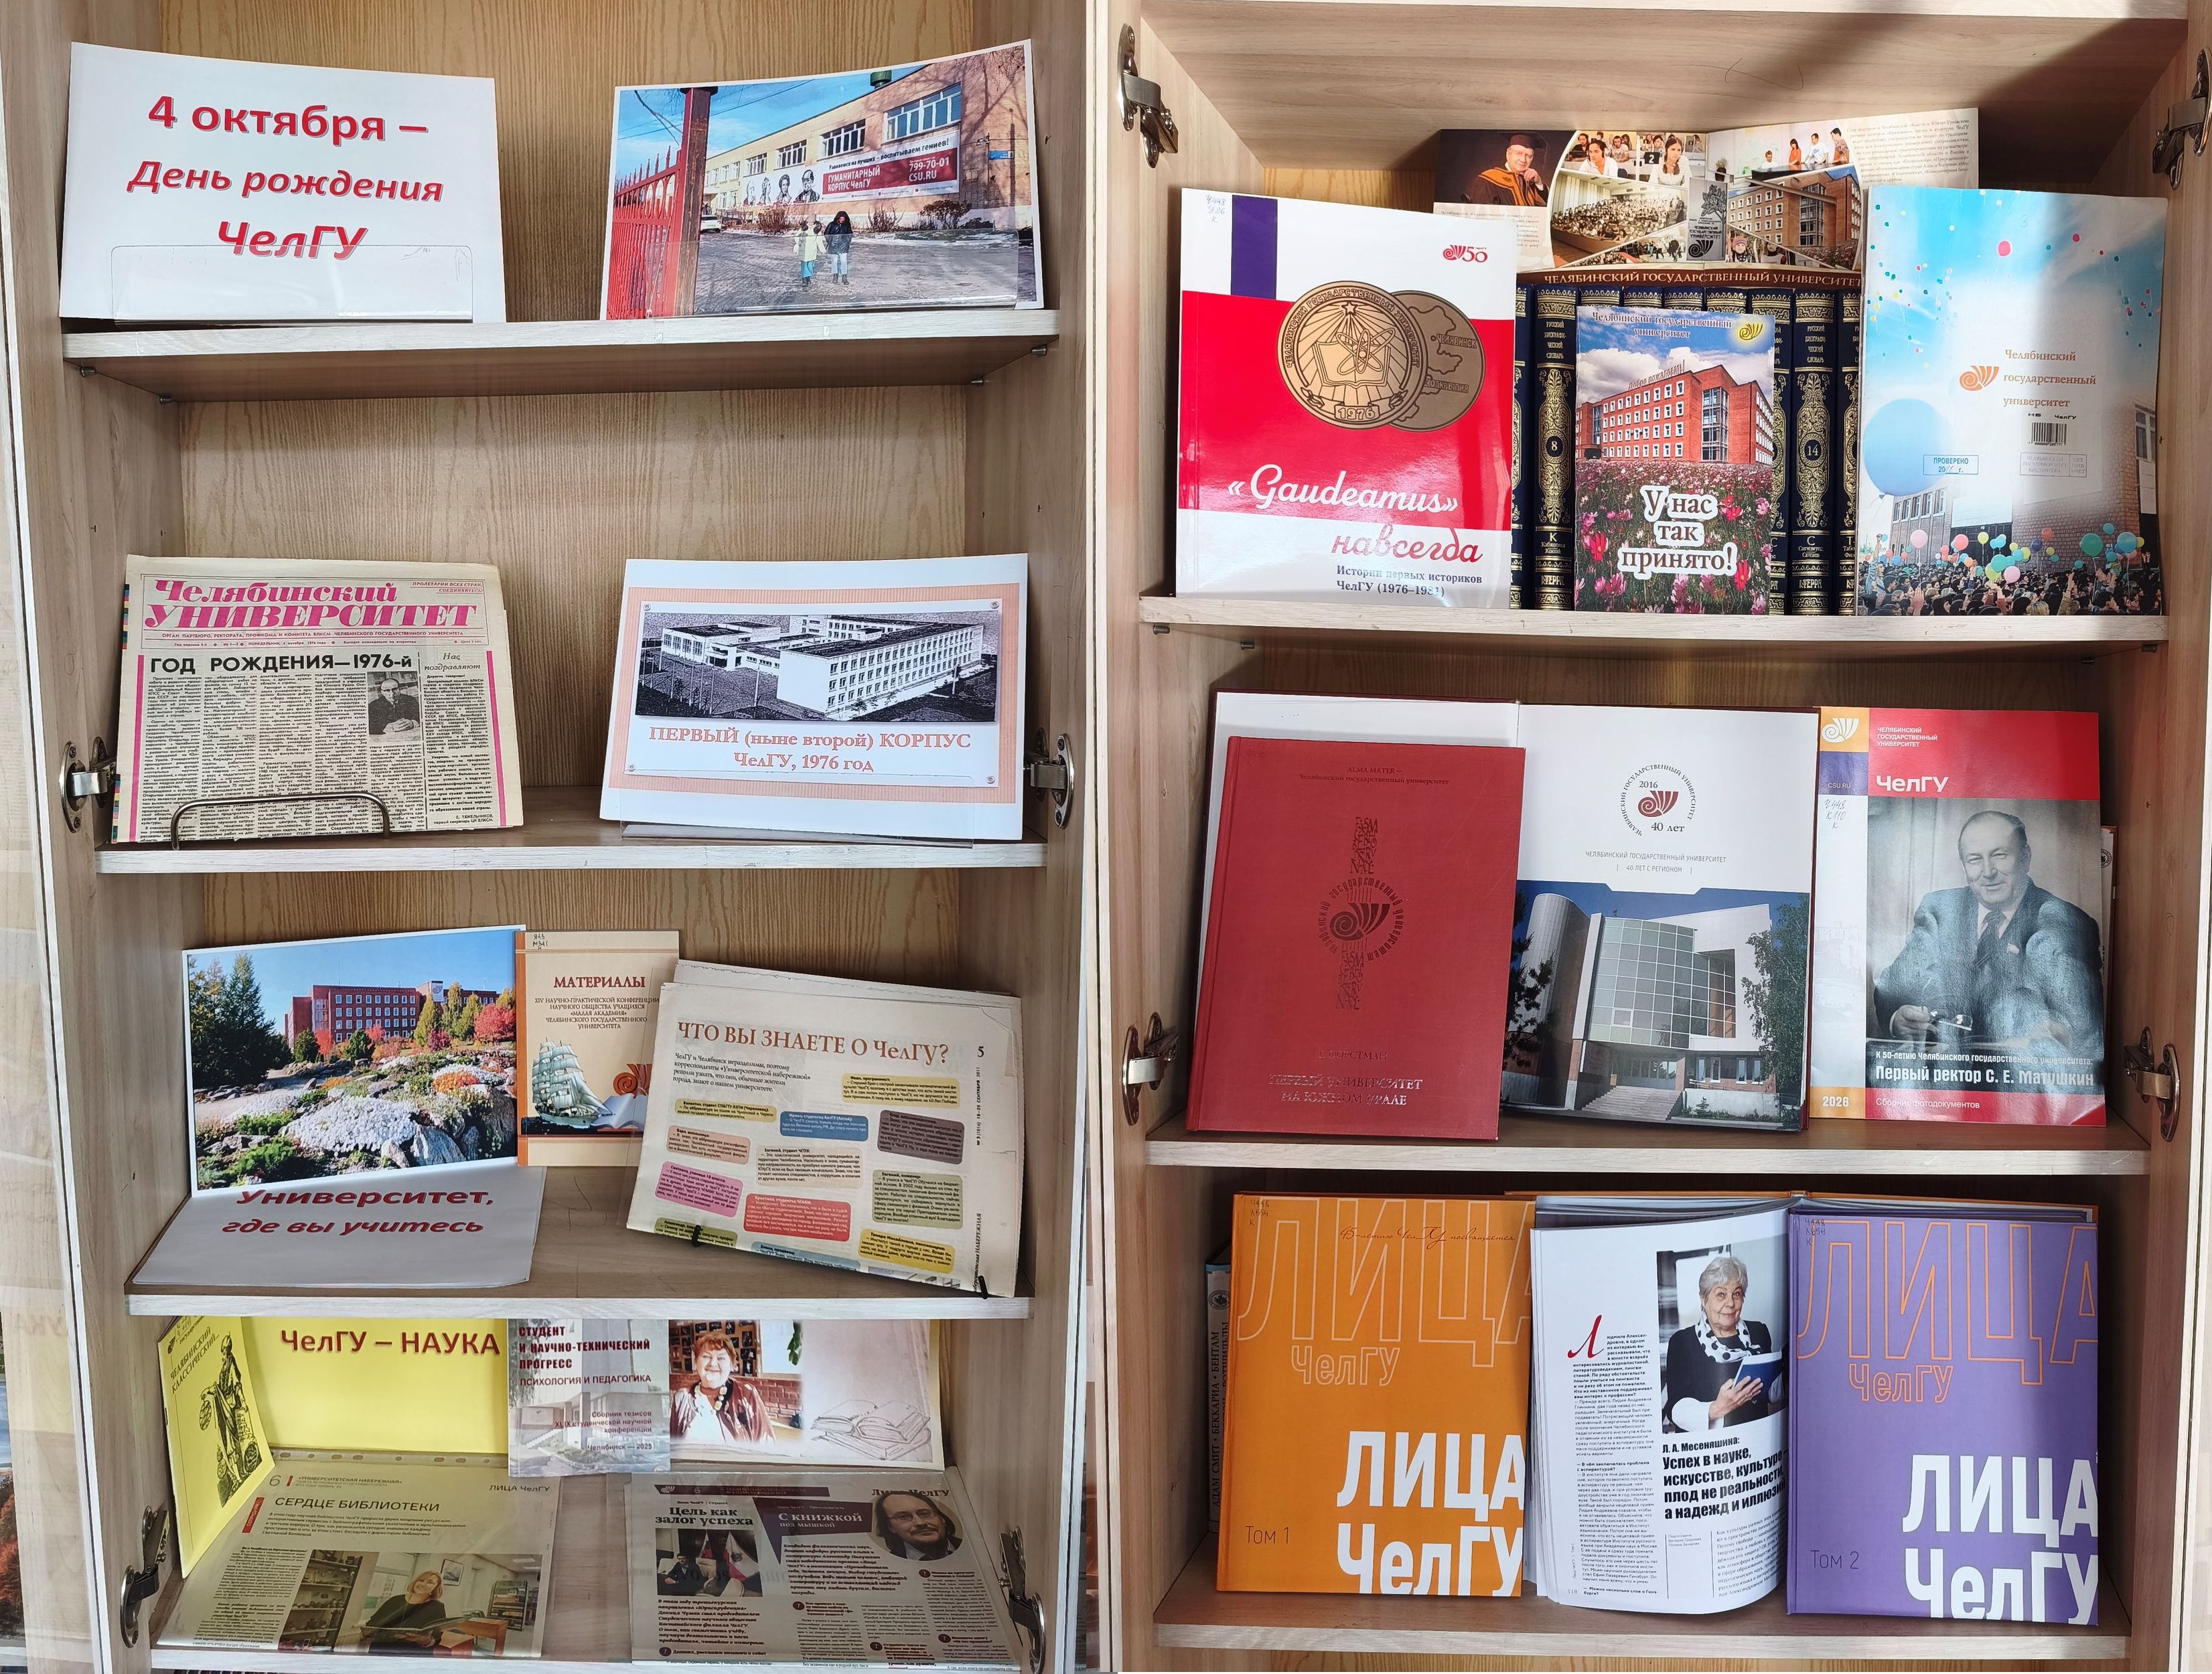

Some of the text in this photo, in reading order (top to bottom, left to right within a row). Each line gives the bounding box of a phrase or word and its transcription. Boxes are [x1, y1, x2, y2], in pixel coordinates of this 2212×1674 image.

[149, 96, 385, 145] 4 октября
[909, 157, 950, 172] 799-70-01
[127, 161, 443, 202] День рождения
[828, 165, 881, 183] ГУМАНИТАРНЫЙ
[909, 169, 938, 182] CSU.RU
[828, 178, 871, 192] КОРПУС ЧелГУ
[218, 221, 368, 260] ЧелГУ
[1544, 271, 1861, 287] ЧЕЛЯБИНСКИЙ ГОСУДАРСТВЕННЫЙ УНИВЕРСИТЕТ
[1593, 311, 1732, 329] Челябинский государственный
[1286, 289, 1420, 368] ЧЕЛЯБИНСКИЙ ГОСУДАРСТВЕННЫЙ УНИВЕРСИТЕТ
[1634, 326, 1691, 339] университет
[1436, 333, 1477, 349] ЧЕЛЯБИНСК
[2005, 350, 2076, 362] Челябинский
[1628, 377, 1647, 391] Добро
[2003, 374, 2096, 385] государственный
[2003, 398, 2070, 408] университет
[1338, 408, 1375, 420] 1976
[1550, 441, 1558, 451] 8
[1807, 445, 1819, 457] 14
[1228, 464, 1459, 514] «Gaudeamus»
[1645, 489, 1712, 517] У нас
[1657, 526, 1699, 541] так
[1807, 536, 1815, 545] С
[1331, 523, 1483, 562] навсегда
[1621, 548, 1733, 573] принято!
[1337, 565, 1482, 584] Истории первых историков
[155, 580, 397, 603] Челябинский
[1337, 581, 1374, 592] ЧелГУ
[145, 604, 477, 627] УНИВЕРСИТЕТ
[443, 652, 461, 661] Нас
[151, 658, 196, 674] ГОД
[424, 664, 481, 672] поздравляют
[649, 726, 972, 751] ПЕРВЫЙ (ныне второй) КОРПУС
[734, 751, 874, 772] ЧелГУ, 1976 год
[1299, 773, 1344, 781] Челябинский
[1345, 775, 1405, 785] государственный
[1639, 781, 1658, 789] 2016
[1876, 775, 1949, 793] ЧелГУ
[1620, 764, 1696, 836] ЧЕЛЯБИНСКИЙ ГОСУДАРСТВЕННЫЙ УНИВЕРСИТЕТ
[1651, 822, 1664, 832] 40
[1585, 850, 1726, 863] ЧЕЛЯБИНСКИЙ ГОСУДАРСТВЕННЫЙ УНИВЕРСИТЕТ
[554, 976, 646, 988] МАТЕРИАЛЫ
[677, 1022, 948, 1065] ЧТО ВЫ ЗНАЕТЕ О ЧелГУ?
[976, 1046, 985, 1057] 5
[1883, 1051, 1917, 1060] 50-летию
[1918, 1053, 1970, 1062] Челябинского
[1972, 1054, 2039, 1065] государственного
[1269, 1073, 1423, 1089] ПЕРВЫЙ УНИВЕРСИТЕТ
[1876, 1065, 2093, 1086] Первый ректор С. Е. Матушкин
[1281, 1091, 1407, 1106] НА ЮЖНОМ УРАЛЕ
[1822, 1095, 1850, 1108] 2026
[1876, 1097, 1980, 1110] Сборник фотодокументов
[236, 1189, 494, 1209] Университет,
[222, 1219, 484, 1236] где вы учитесь
[1797, 1219, 2097, 1385] ЛИЦА
[519, 1326, 565, 1337] СТУДЕНТ
[281, 1330, 501, 1356] ЧелГУ НАУКА
[520, 1338, 650, 1353] И НАУЧНО-ТЕХНИЧЕСКИЙ
[170, 1326, 211, 1380] ЧЕЛЯБИНСКИЙ
[520, 1359, 572, 1369] ПРОГРЕСС
[1292, 1345, 1400, 1386] ЧелГУ
[520, 1377, 581, 1386] ПСИХОЛОГИЯ
[593, 1375, 651, 1384] ПЕДАГОГИКА
[1848, 1363, 1953, 1403] ЧелГУ
[573, 1419, 621, 1428] студенческой
[1211, 1331, 1220, 1507] АДАМ СМИТ БЕККАРИА БЕНТАМ
[587, 1444, 625, 1452] Челябинск
[1662, 1437, 1740, 1453] Л. А. Месеняшина:
[1663, 1447, 1751, 1470] Успех в науке,
[1337, 1430, 1525, 1521] ЛИЦА
[1664, 1450, 1783, 1487] искусстве, культуре
[490, 1485, 518, 1493] ЛИЦА
[1664, 1490, 1698, 1503] плод
[1701, 1488, 1717, 1499] не
[275, 1497, 440, 1511] СЕРДЦЕ БИБЛИОТЕКИ
[1665, 1478, 1786, 1519] а надежд и иллюзий
[1902, 1454, 2097, 1547] ЛИЦА
[669, 1507, 738, 1518] Цель как
[779, 1513, 863, 1522] С книжкой
[654, 1517, 753, 1526] залог успеха
[1245, 1525, 1289, 1545] Том 1
[1336, 1523, 1523, 1596] ЧелГУ
[1811, 1550, 1859, 1570] Том 2
[1905, 1548, 2097, 1624] ЧелГУ
